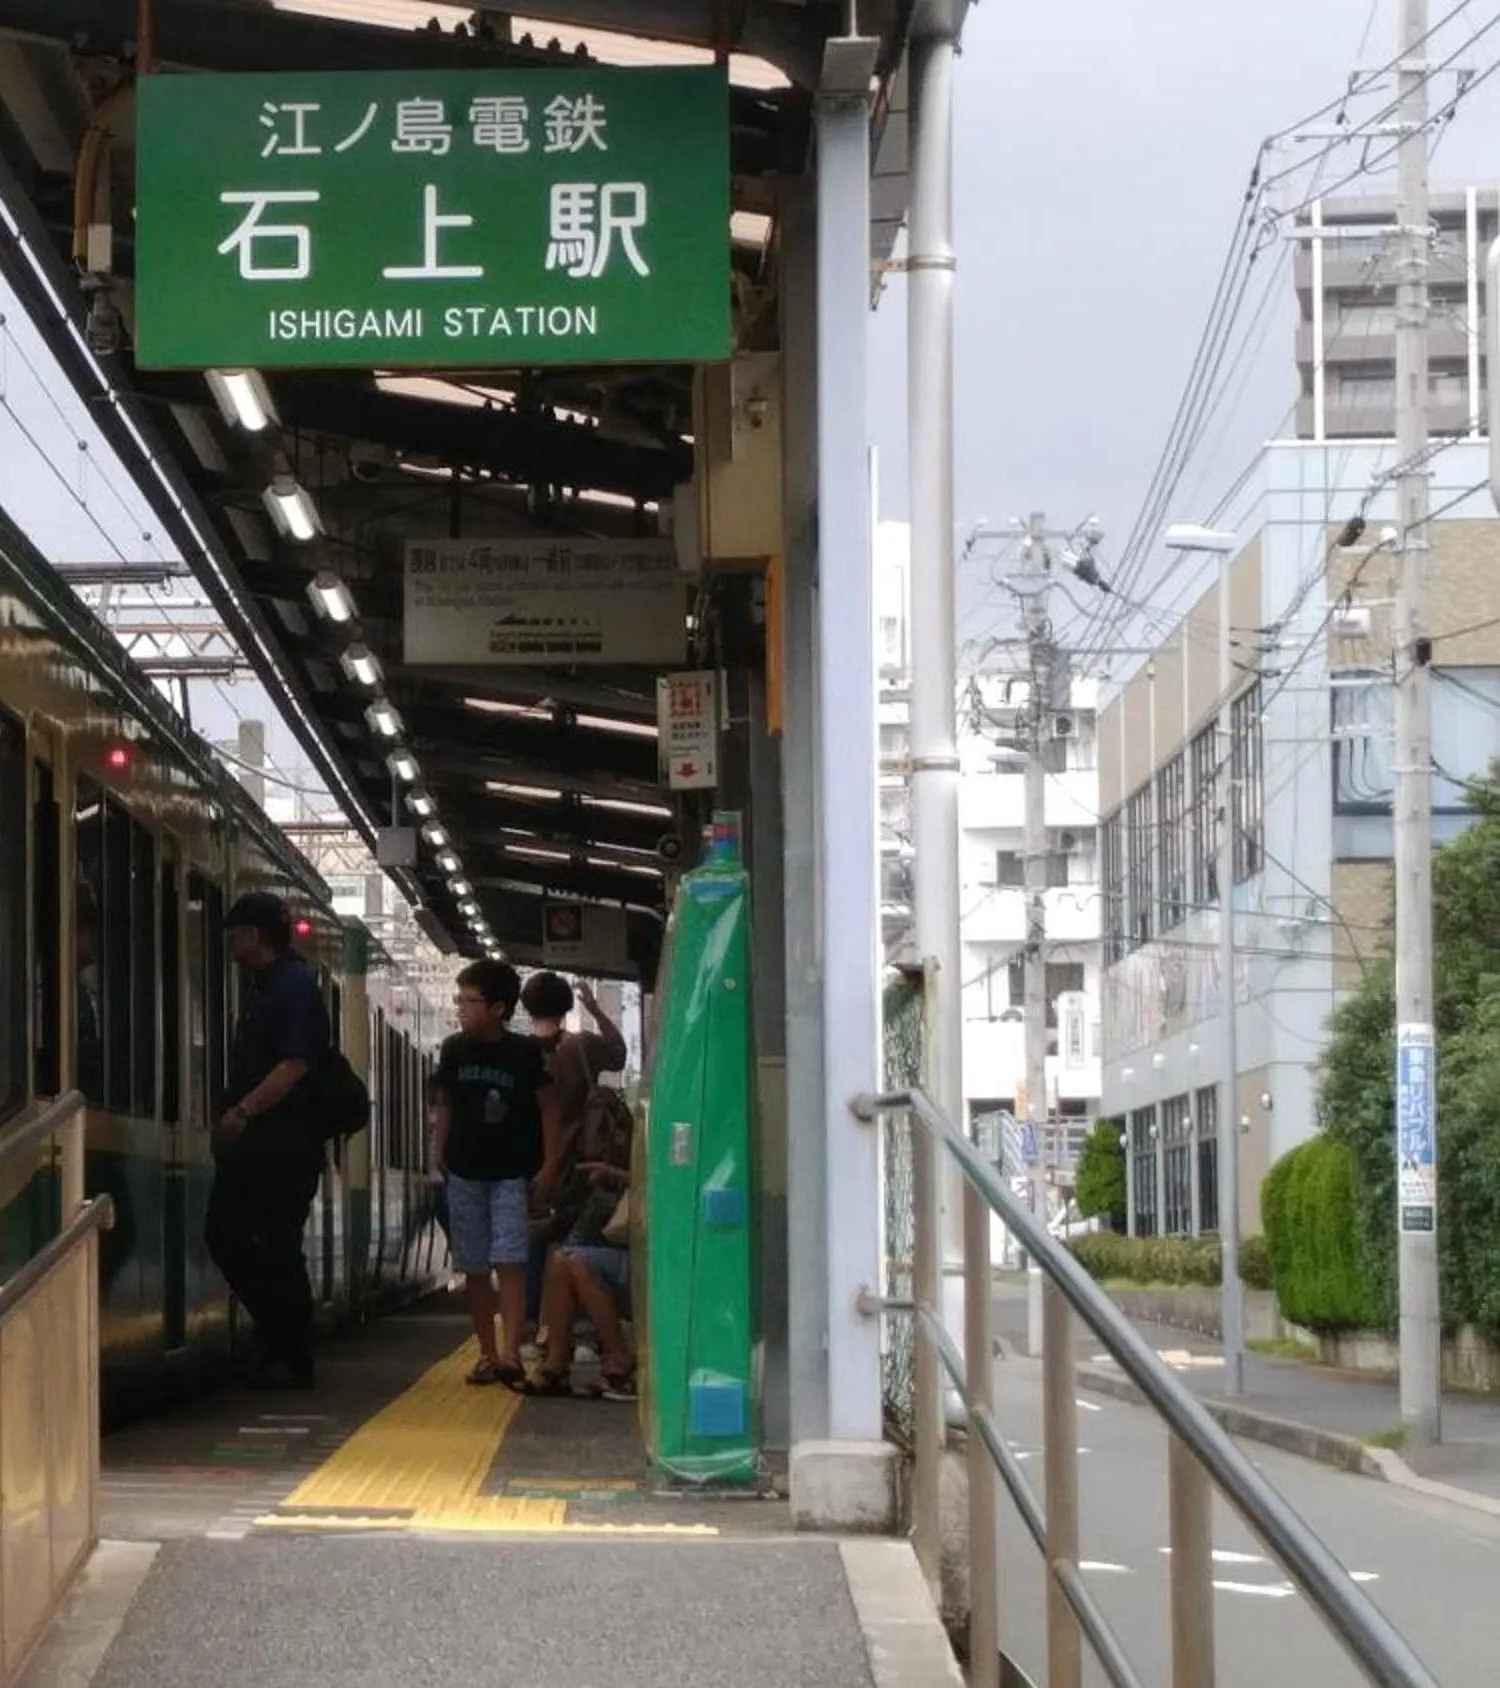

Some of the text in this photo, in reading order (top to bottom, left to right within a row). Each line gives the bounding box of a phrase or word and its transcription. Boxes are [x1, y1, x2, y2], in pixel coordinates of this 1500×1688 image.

[259, 93, 609, 158] 江ノ島電鉄
[216, 181, 651, 281] 石上駅
[269, 305, 597, 340] ISHIGAMI STATION
